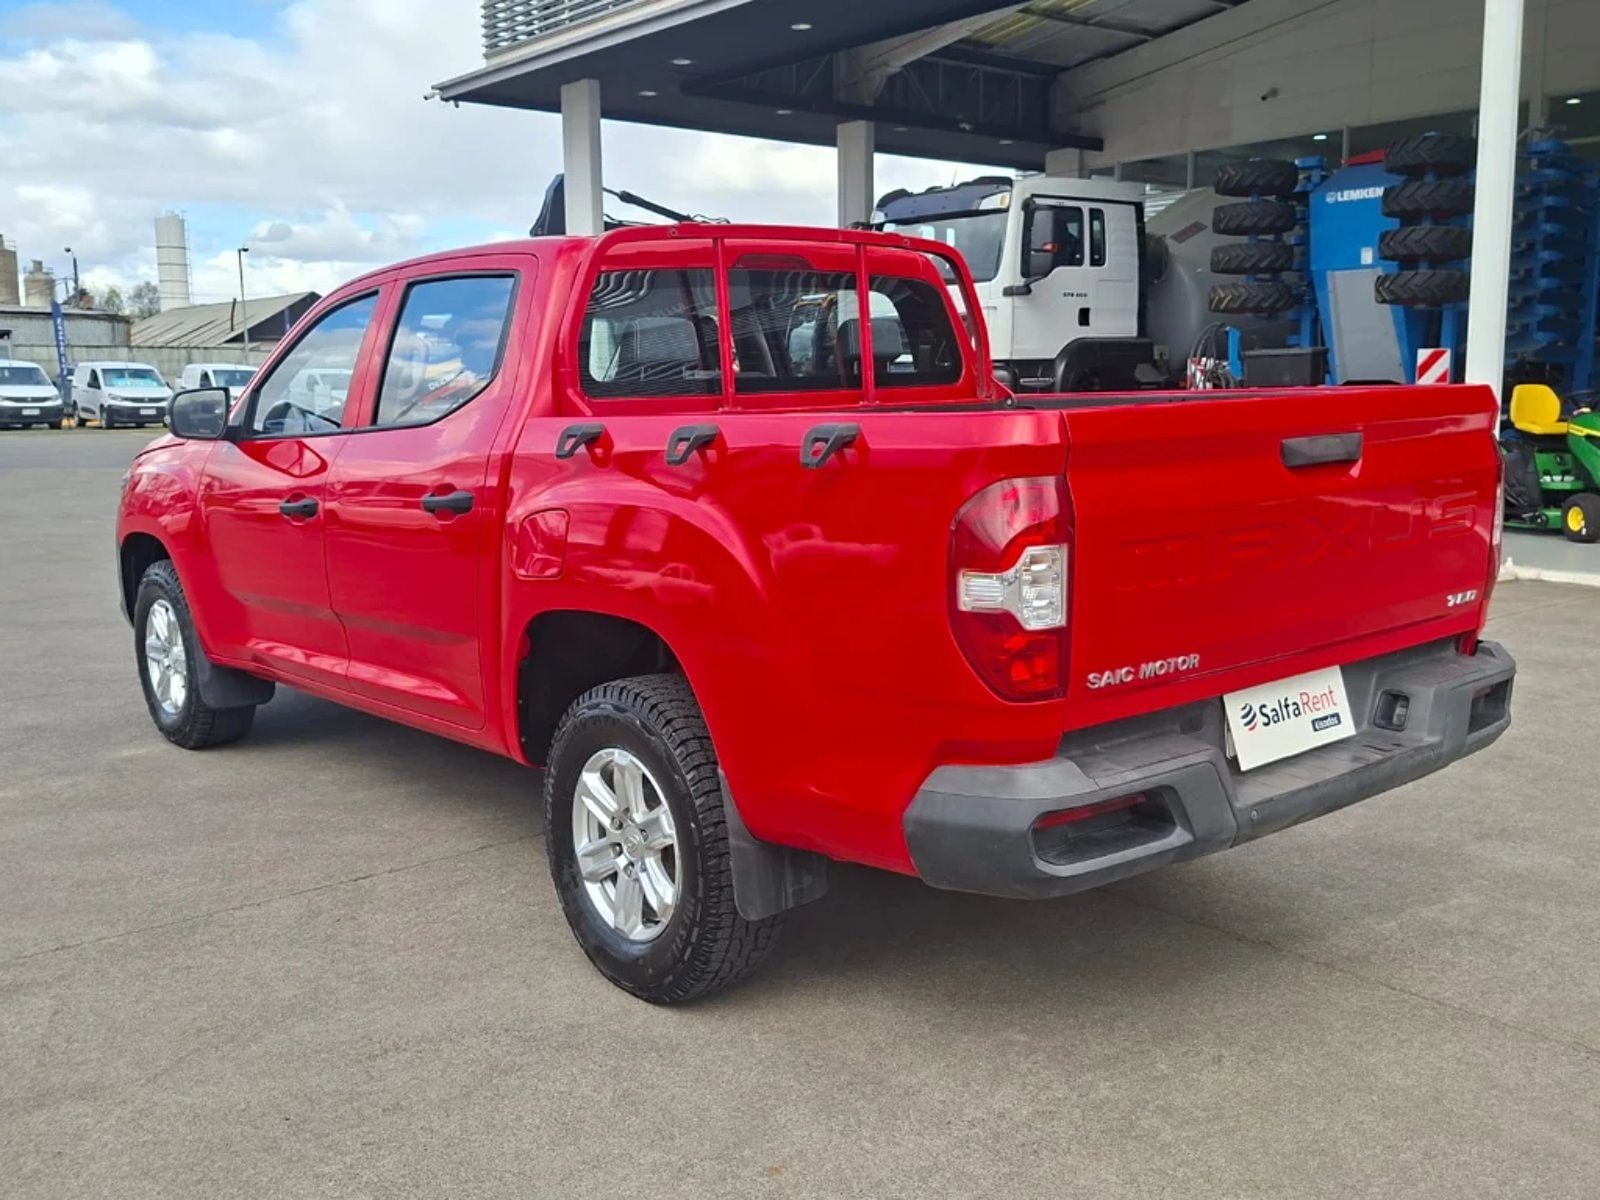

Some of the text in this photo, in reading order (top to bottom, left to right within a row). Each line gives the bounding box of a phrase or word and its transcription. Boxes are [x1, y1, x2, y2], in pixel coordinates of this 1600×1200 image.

[1337, 186, 1385, 202] LEMKEN
[1086, 653, 1200, 689] SAIC MOTOR
[1258, 685, 1338, 727] SalfaRent
